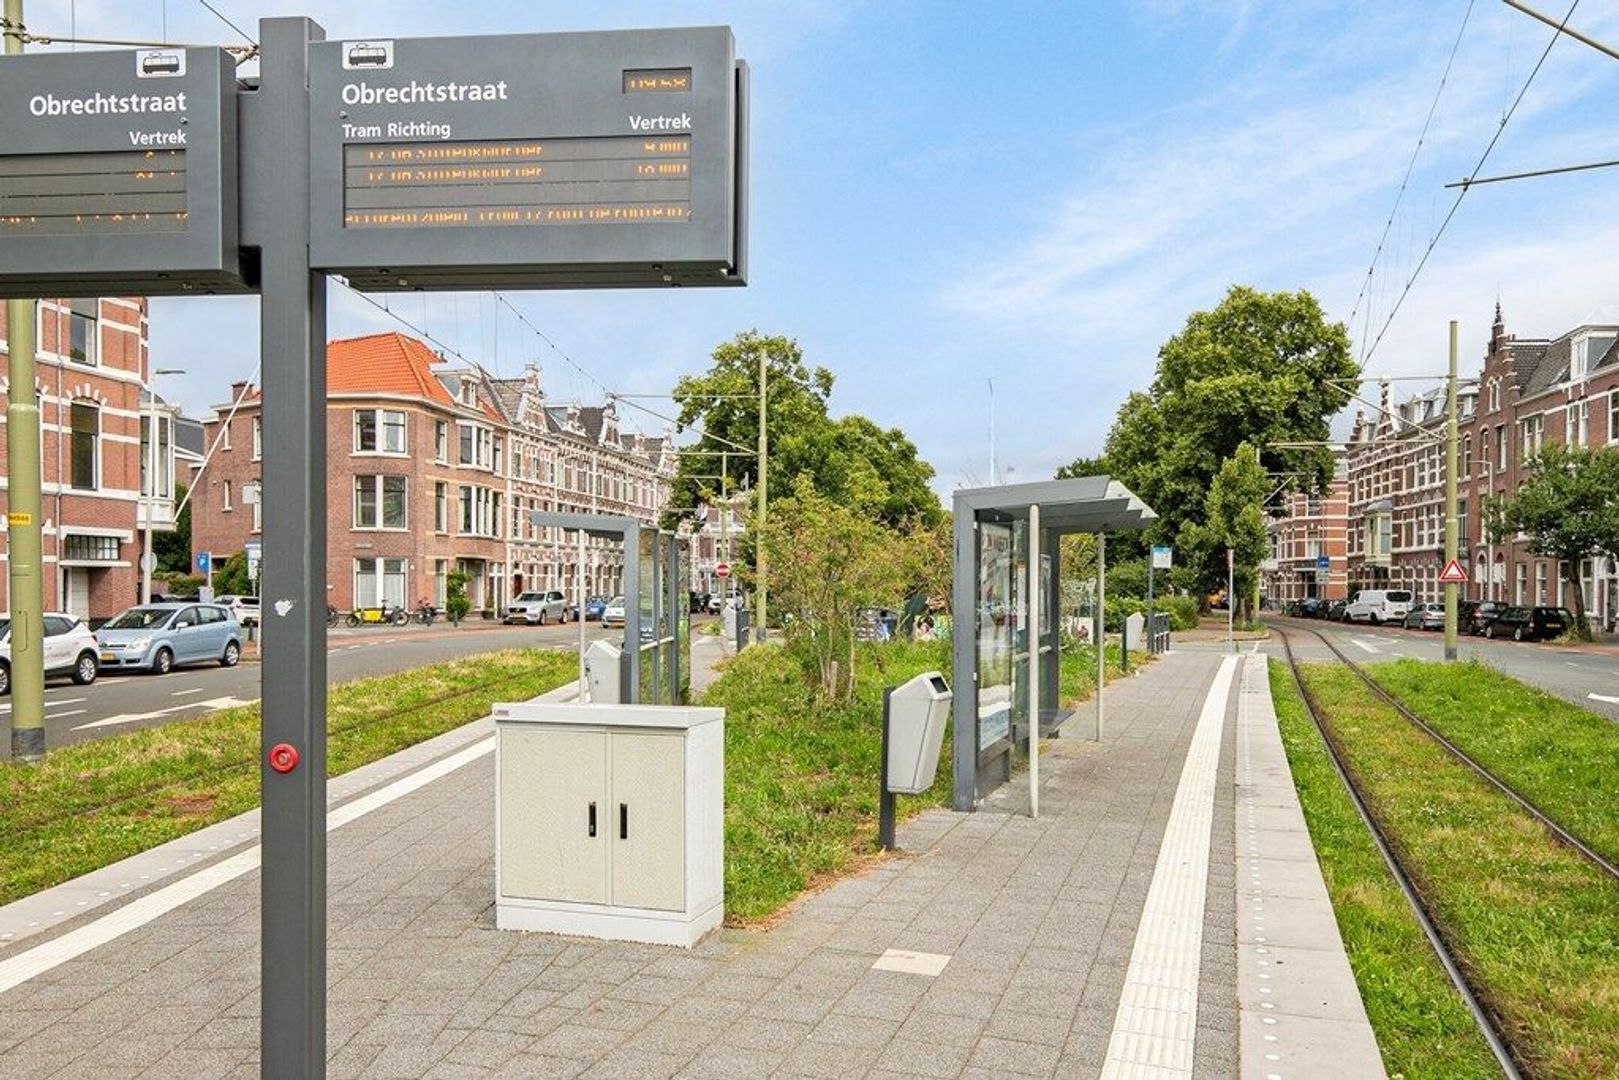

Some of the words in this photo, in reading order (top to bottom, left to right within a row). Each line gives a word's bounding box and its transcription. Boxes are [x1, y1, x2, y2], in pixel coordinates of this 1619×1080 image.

[341, 81, 508, 105] Obrechtstraat
[29, 92, 187, 116] Obrechtstraat
[342, 124, 381, 138] Tram
[388, 121, 451, 139] Richting
[629, 113, 692, 130] Vertrek
[129, 129, 187, 145] Vertrek
